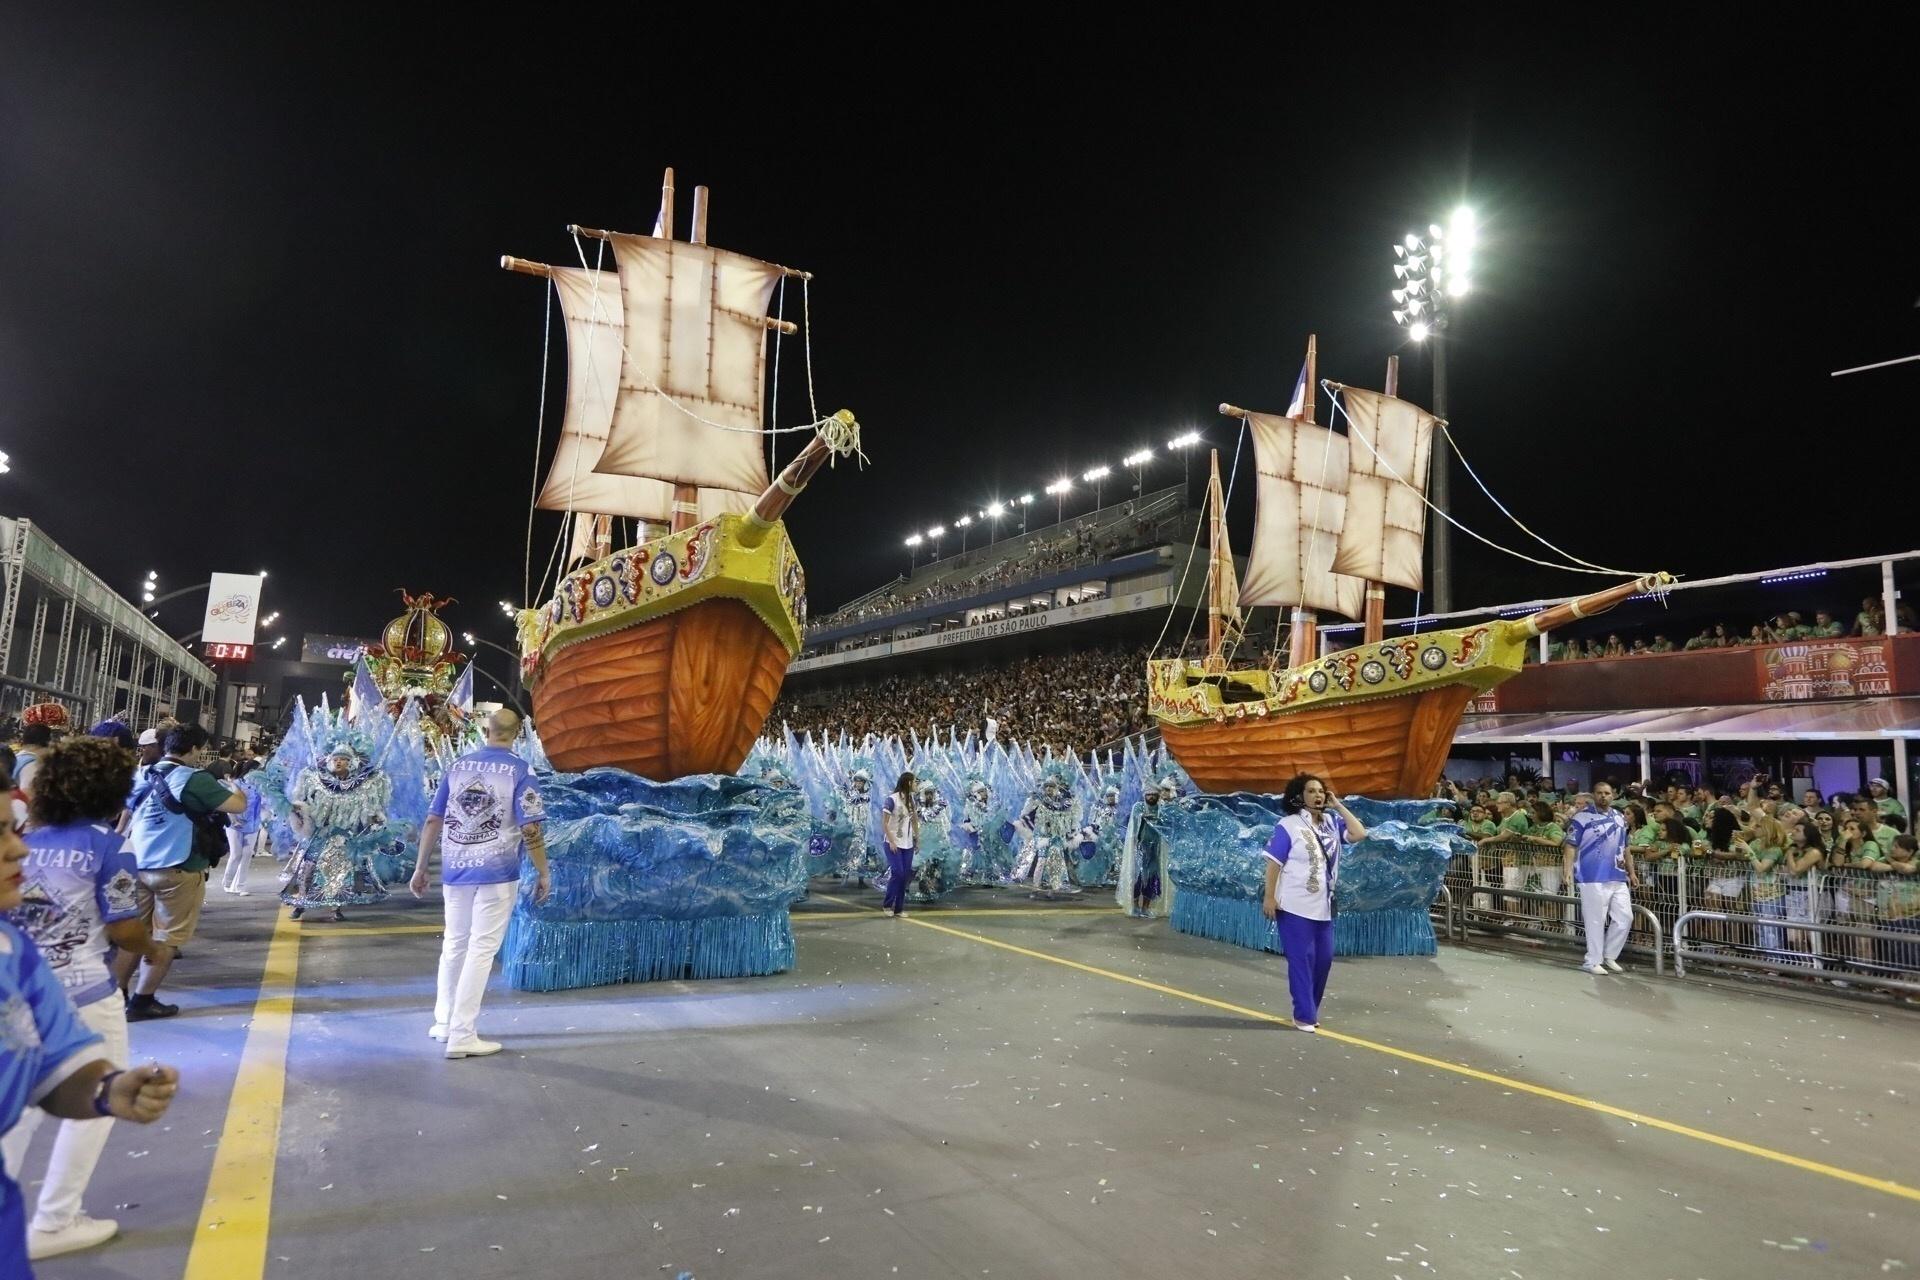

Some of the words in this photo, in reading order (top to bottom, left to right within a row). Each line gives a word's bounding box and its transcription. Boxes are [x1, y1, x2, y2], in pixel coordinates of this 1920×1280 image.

[943, 626, 986, 644] PREFEITURA
[988, 624, 998, 636] DE
[1000, 620, 1017, 634] SÃO
[1020, 614, 1047, 629] PAULO
[215, 644, 247, 659] 0:14
[327, 645, 363, 664] cref
[449, 858, 485, 869] 2018
